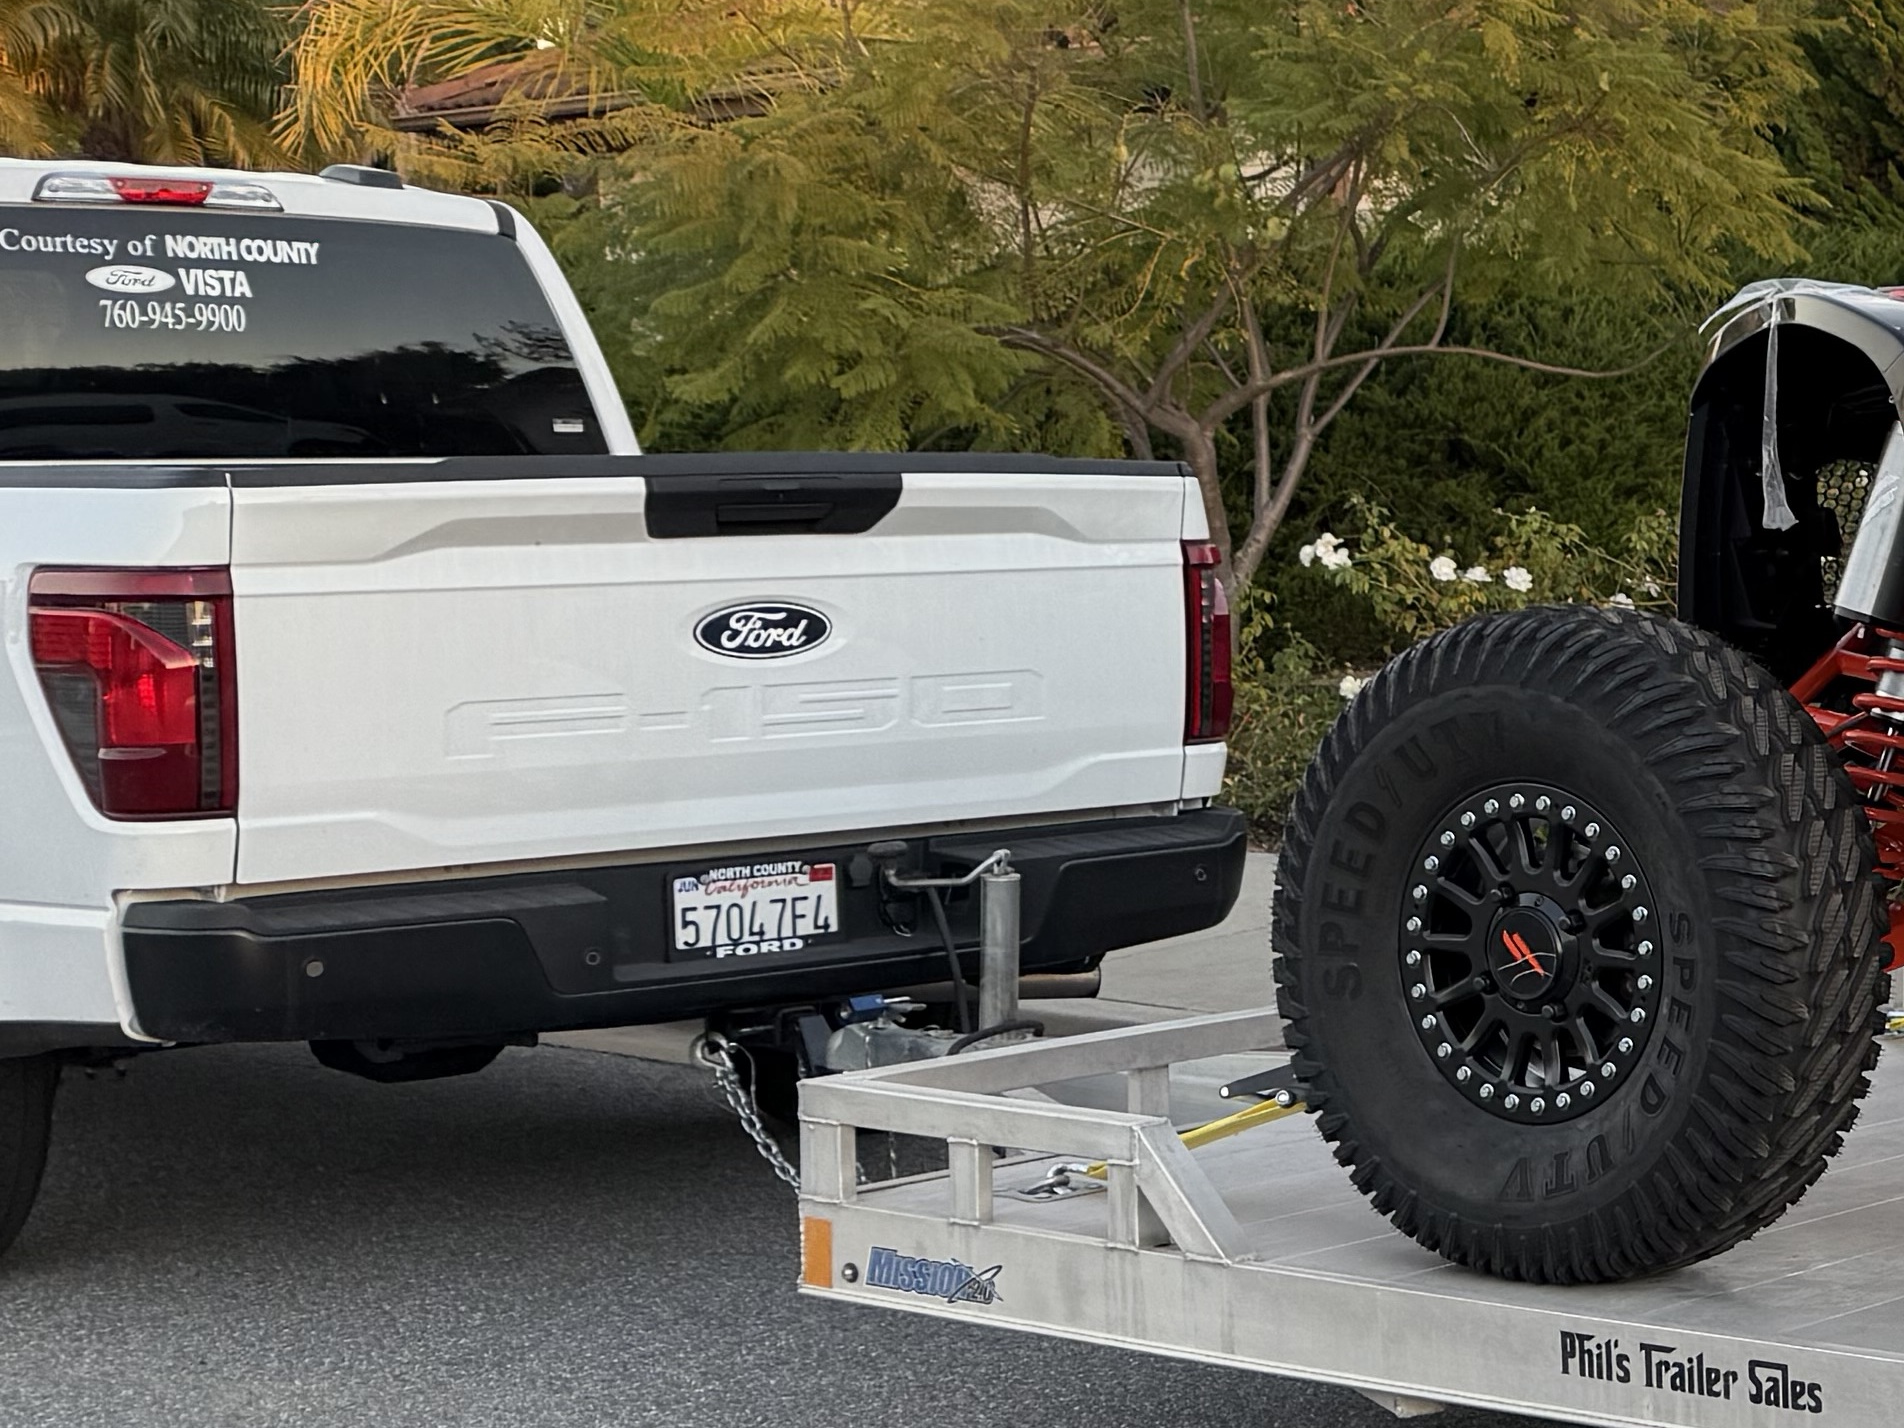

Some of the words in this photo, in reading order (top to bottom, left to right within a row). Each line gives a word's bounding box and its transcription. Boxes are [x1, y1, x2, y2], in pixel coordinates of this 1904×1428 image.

[0, 227, 118, 260] Courtesy
[127, 234, 156, 257] of
[164, 234, 237, 260] NORTH
[240, 238, 319, 265] COUNTY
[177, 267, 253, 298] VISTA
[99, 299, 246, 332] 760-945-9900
[719, 609, 808, 650] Ford
[704, 875, 810, 899] California
[708, 865, 751, 881] NORTH
[753, 861, 802, 877] COUNTY
[681, 894, 831, 948] 57047F4
[1318, 800, 1388, 1003] SPEED
[716, 938, 804, 959] FORD
[1640, 910, 1695, 1117] SPEED
[1498, 1133, 1616, 1203] UTV
[866, 1246, 973, 1300] MISSION
[1560, 1330, 1631, 1384] Phil's
[1639, 1342, 1738, 1401] Trailer
[1748, 1359, 1823, 1414] Sales
